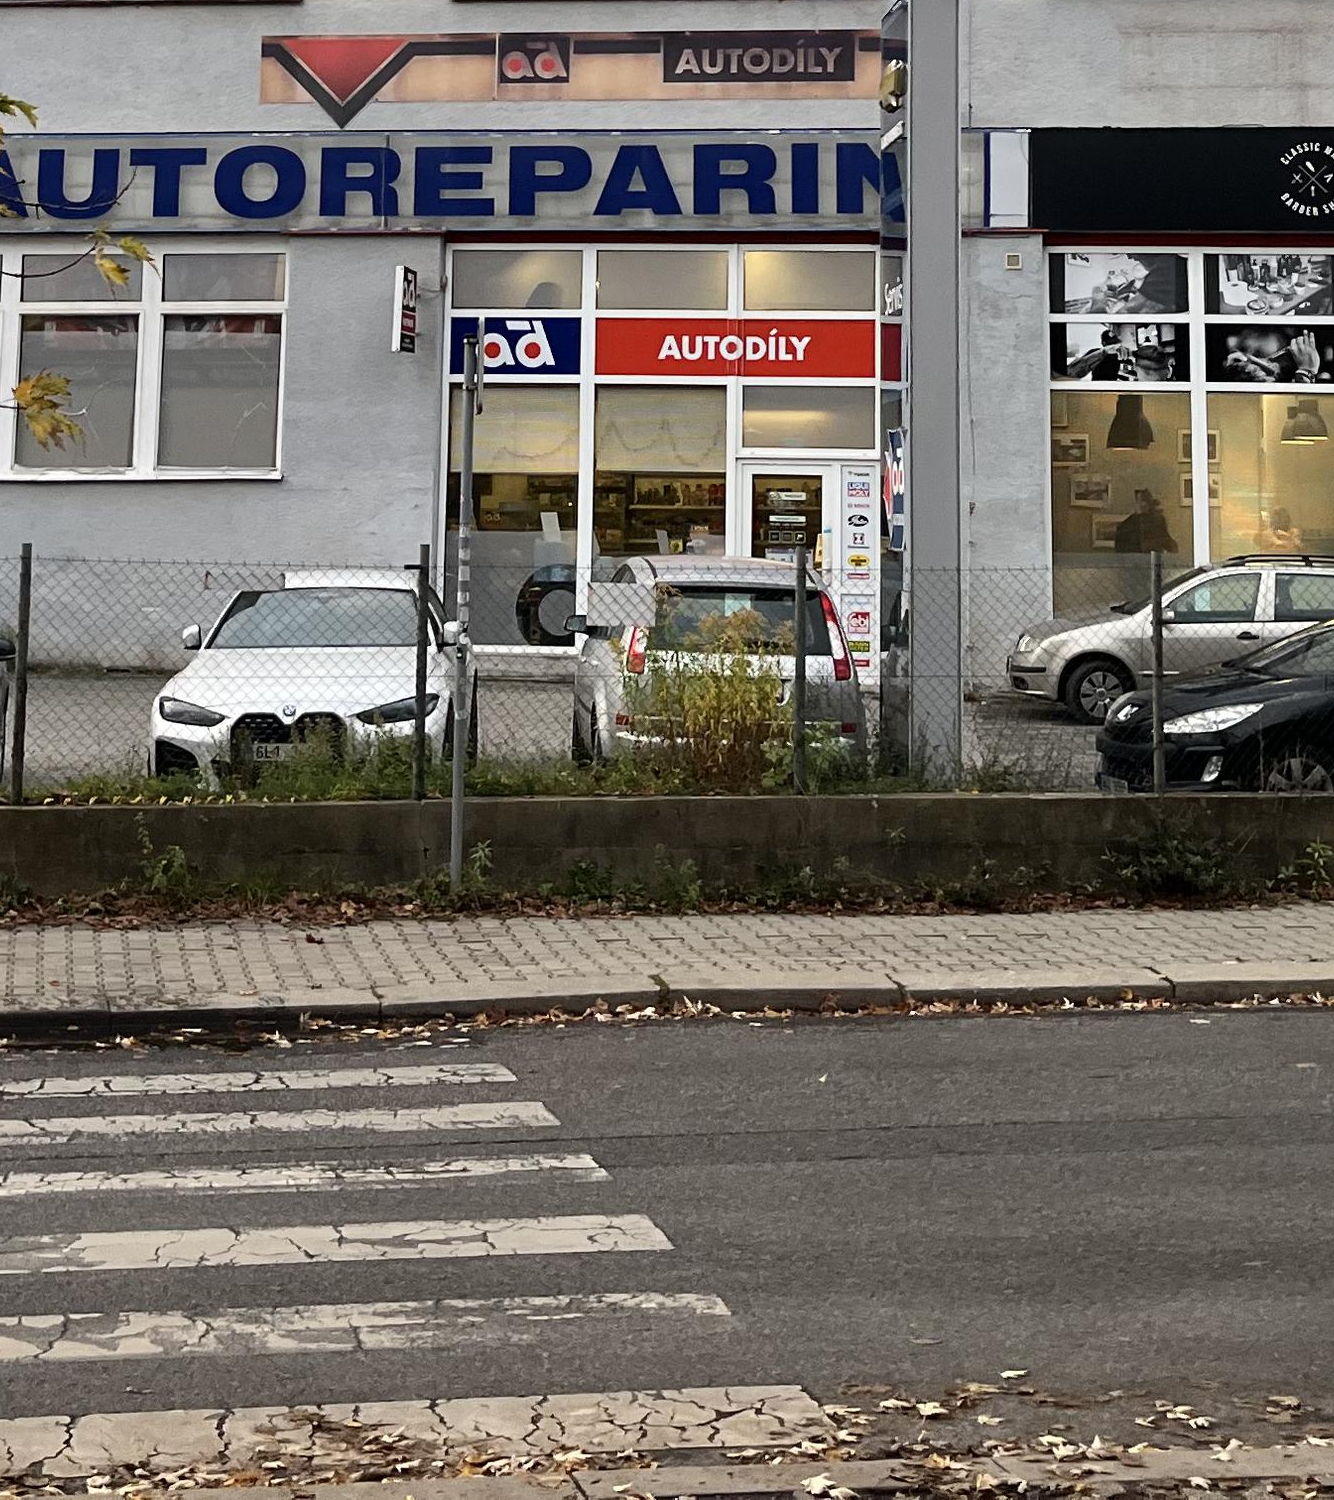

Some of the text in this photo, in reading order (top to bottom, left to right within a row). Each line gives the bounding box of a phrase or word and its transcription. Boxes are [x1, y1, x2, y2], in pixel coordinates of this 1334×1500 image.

[502, 40, 843, 80] ad AUTODÍLY
[1280, 142, 1321, 165] CLASSIC
[1280, 192, 1319, 216] BARBER
[475, 320, 812, 368] ad AUTODÍLY
